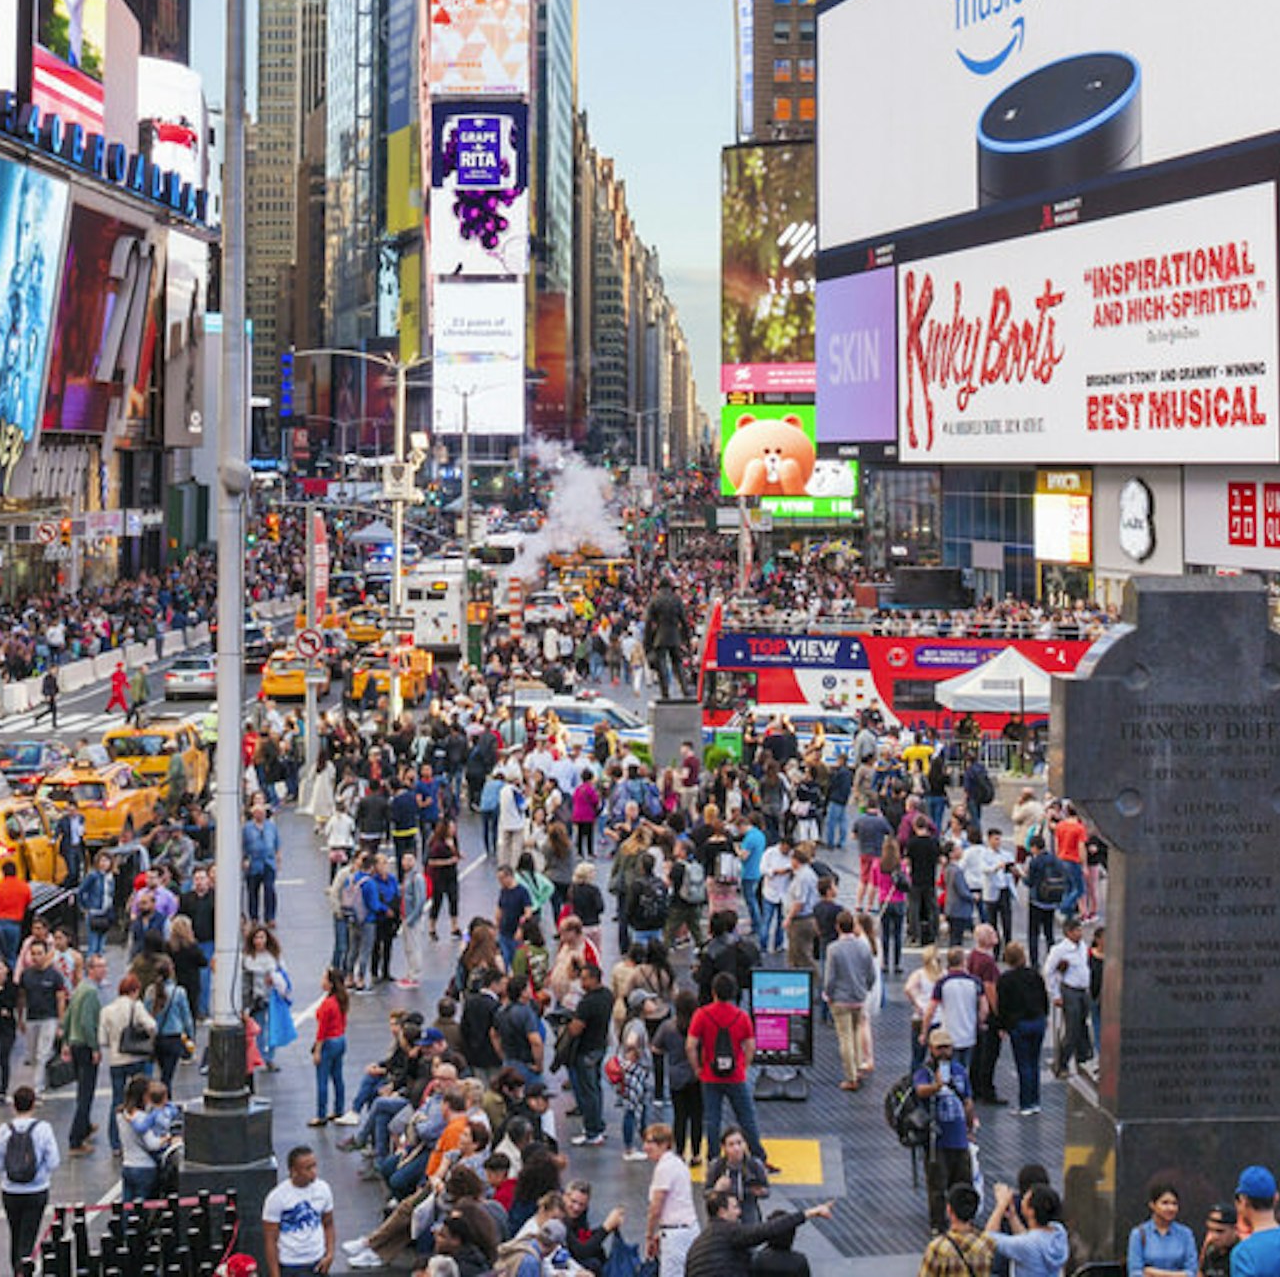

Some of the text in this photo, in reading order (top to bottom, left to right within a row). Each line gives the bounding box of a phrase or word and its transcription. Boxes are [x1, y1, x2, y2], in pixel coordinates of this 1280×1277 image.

[460, 130, 498, 144] GRAPE
[460, 151, 498, 168] RITA
[1093, 298, 1125, 327] AND
[828, 328, 881, 383] SKIN
[904, 269, 1066, 451] Kinky Boots
[1086, 391, 1145, 431] BEST
[1148, 384, 1268, 430] MUSICAL
[748, 638, 841, 657] TOPVIEW
